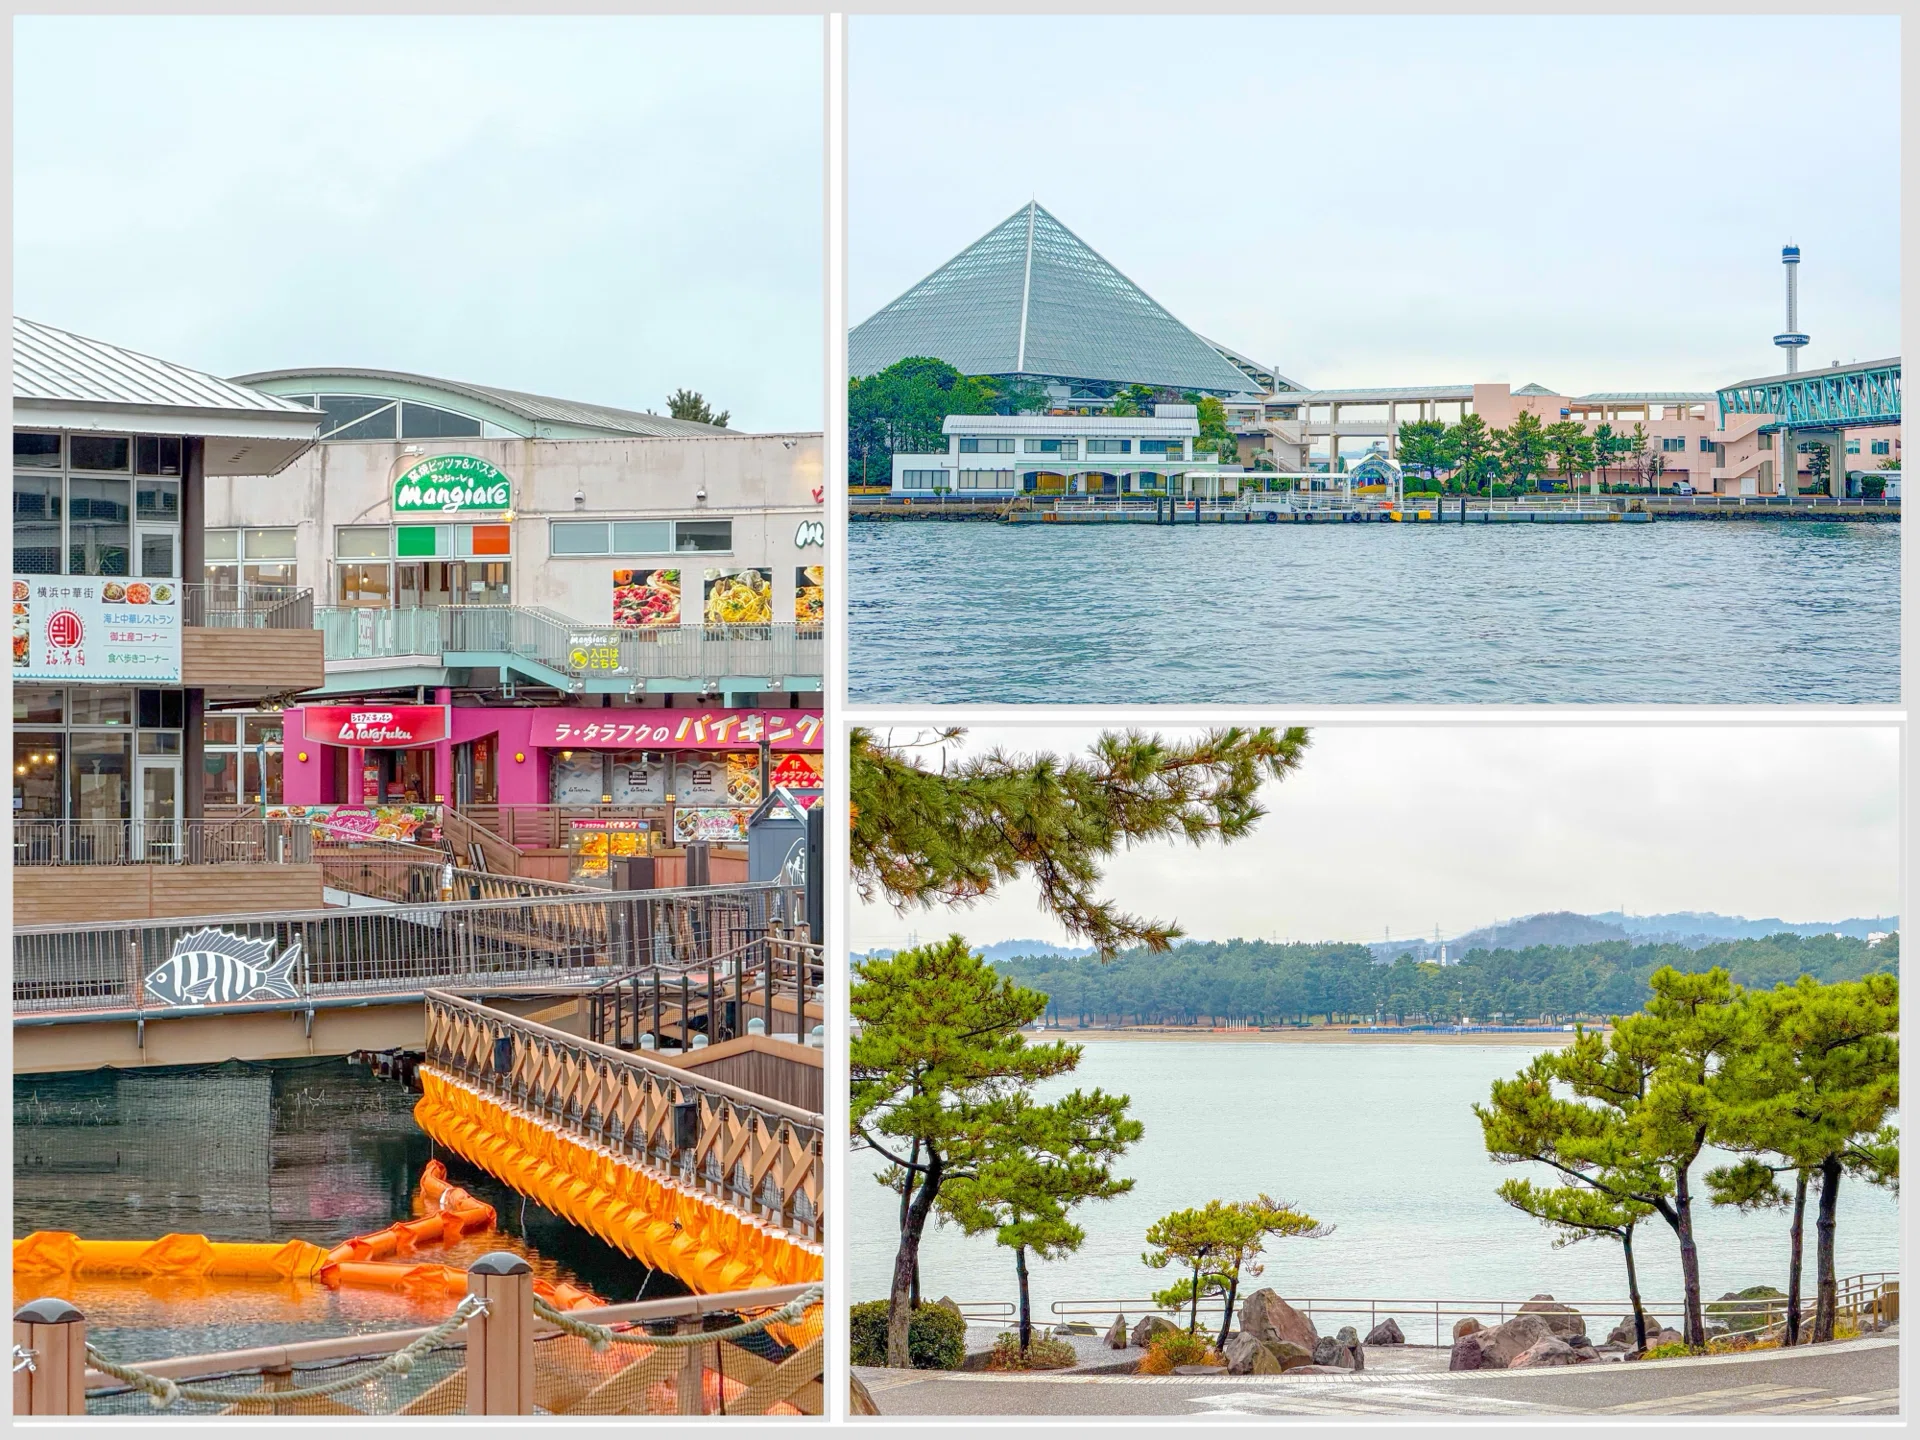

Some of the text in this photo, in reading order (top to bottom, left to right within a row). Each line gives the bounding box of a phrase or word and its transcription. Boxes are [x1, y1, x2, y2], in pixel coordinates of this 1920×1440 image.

[37, 586, 94, 599] 横浜中華街
[103, 613, 175, 625] 海上中華レストラン
[109, 631, 168, 642] 御土産コーナー
[107, 653, 170, 664] 食べ歩きコーナー
[590, 648, 619, 659] 入口は
[590, 658, 619, 669] こちら
[554, 713, 824, 745] ラ・タラフクの バイキング
[789, 760, 801, 769] 1F
[770, 771, 817, 780] ラ・タラフクの
